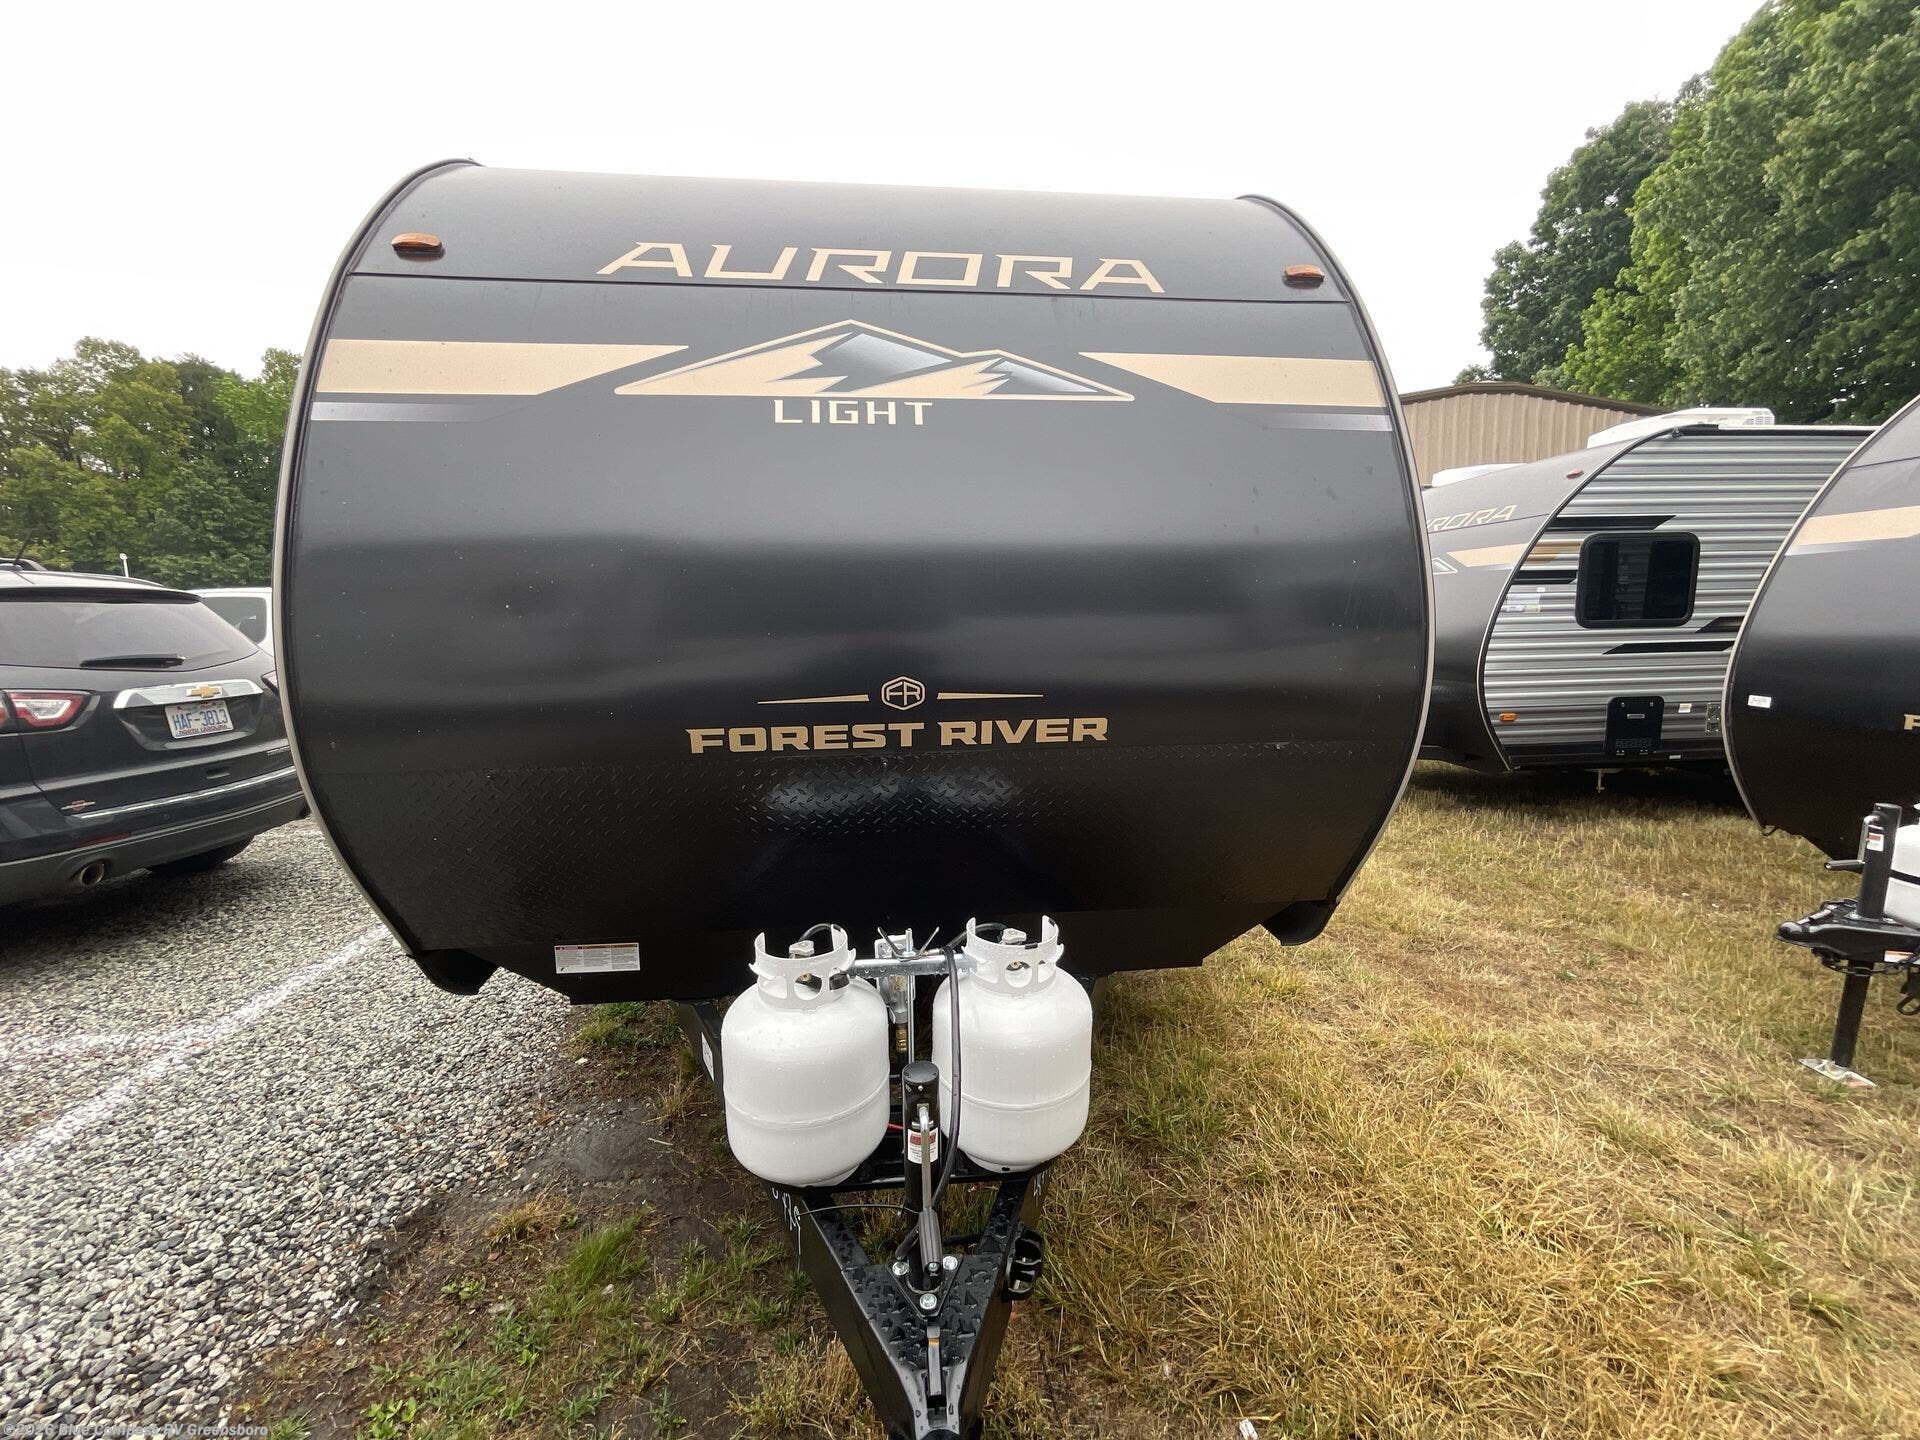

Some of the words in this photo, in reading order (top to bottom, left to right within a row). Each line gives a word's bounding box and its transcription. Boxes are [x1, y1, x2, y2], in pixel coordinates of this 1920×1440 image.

[597, 241, 1165, 293] AURORA
[773, 399, 933, 425] LIGHT
[1427, 504, 1517, 531] RORA
[685, 722, 925, 754] FOREST
[936, 717, 1109, 746] RIVER
